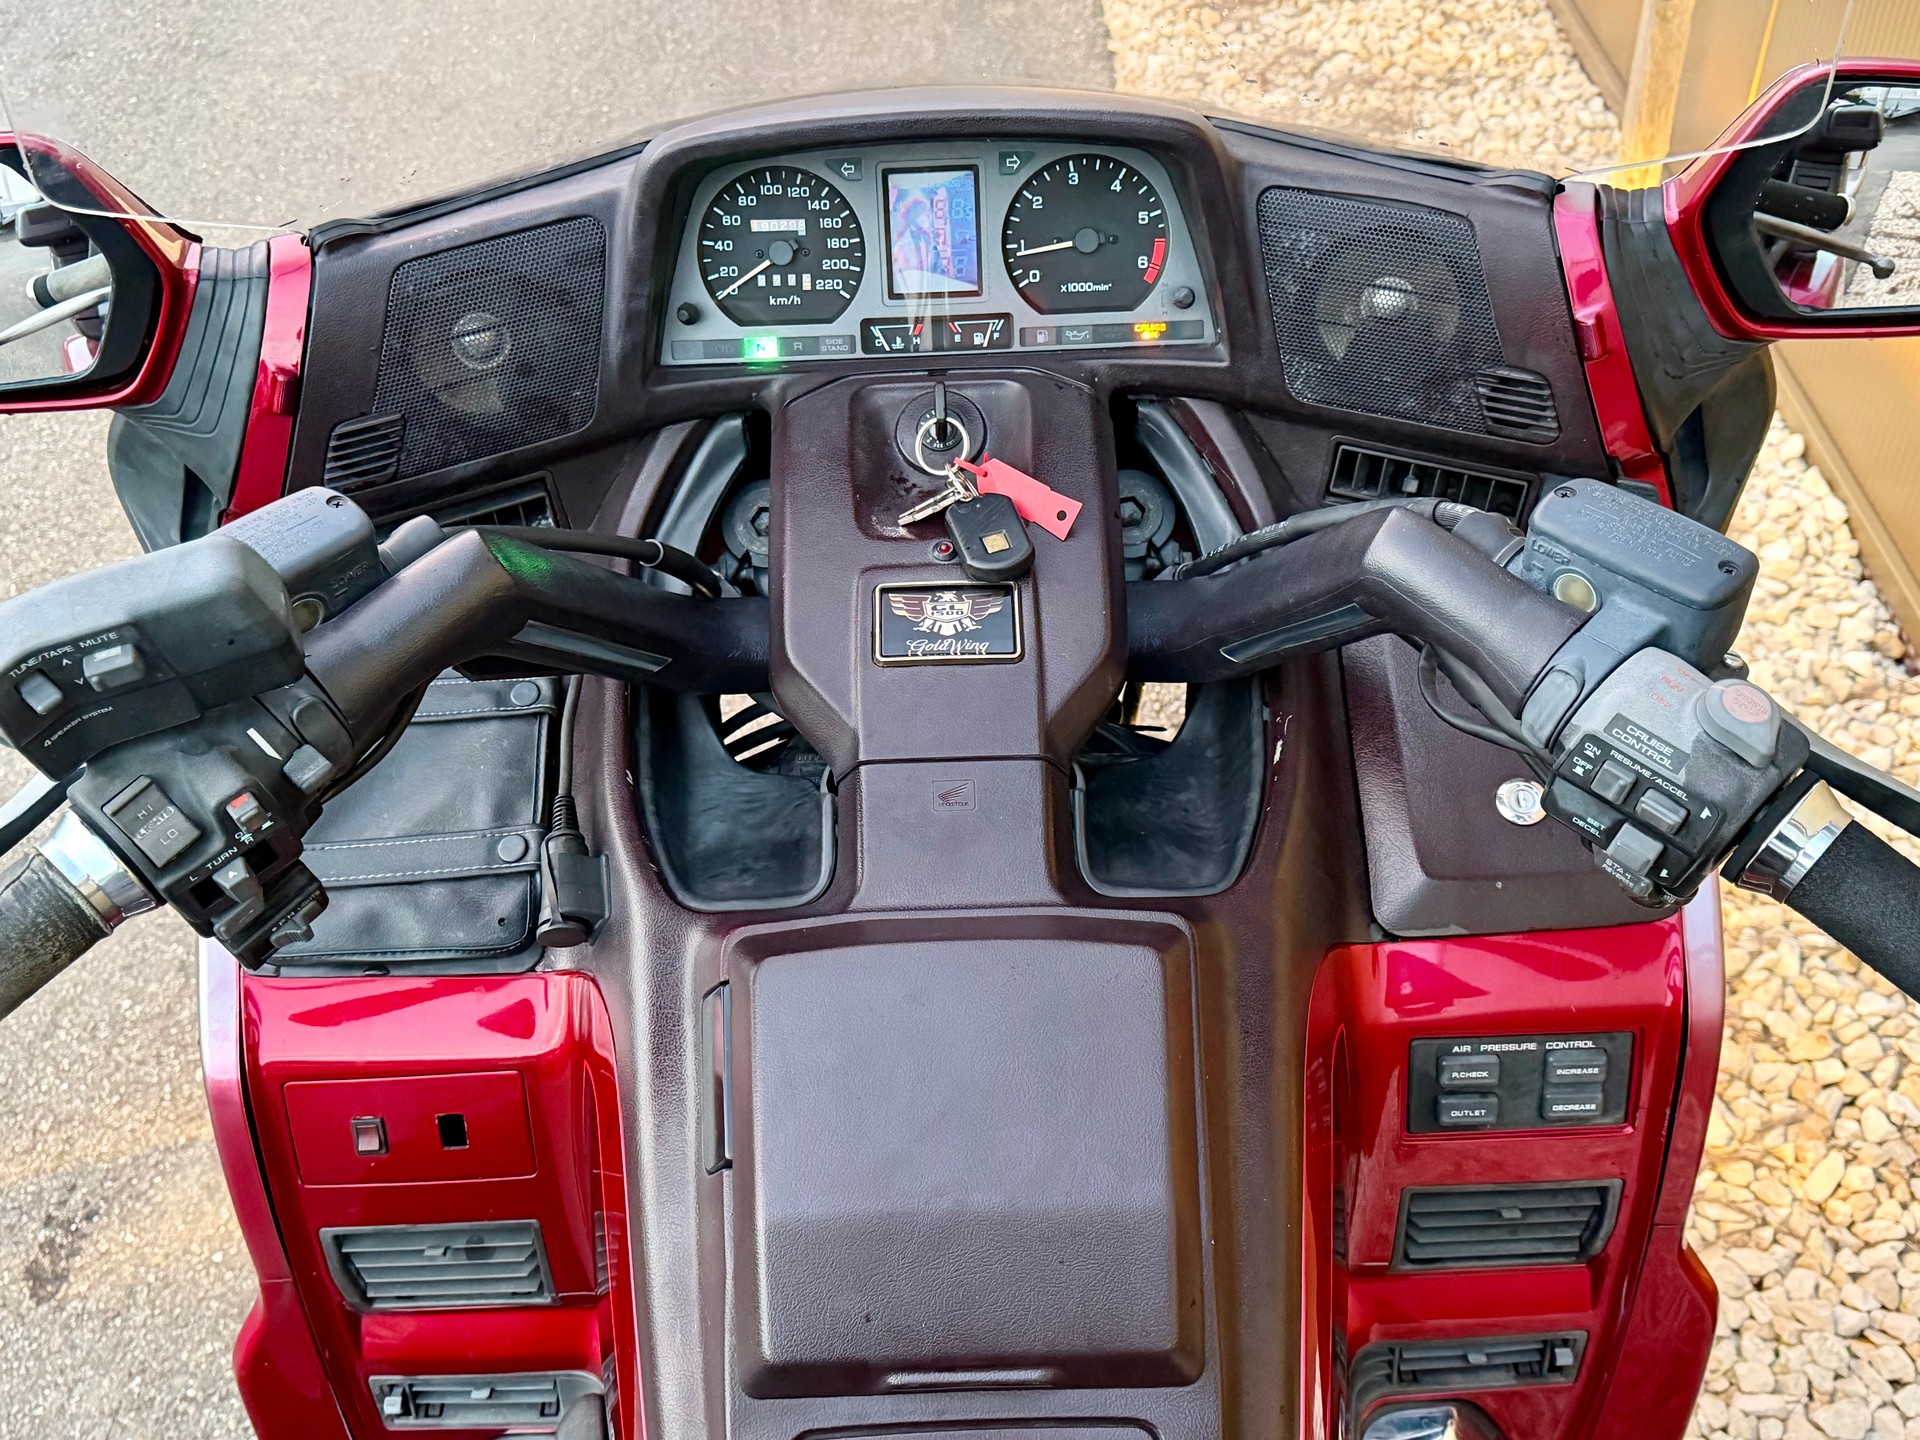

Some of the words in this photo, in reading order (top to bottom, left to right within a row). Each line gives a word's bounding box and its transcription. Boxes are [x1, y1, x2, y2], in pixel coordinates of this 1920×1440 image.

[1068, 174, 1079, 185] 3
[760, 185, 783, 196] 100
[1110, 180, 1122, 192] 4
[787, 187, 810, 198] 120
[738, 196, 757, 207] 80
[807, 200, 830, 211] 140
[1032, 197, 1043, 209] 2
[722, 215, 741, 226] 60
[819, 218, 842, 229] 160
[1138, 212, 1149, 224] 5
[714, 240, 733, 251] 40
[827, 238, 850, 249] 180
[822, 259, 850, 270] 200
[1138, 256, 1149, 268] 6
[720, 266, 739, 277] 20
[1029, 270, 1040, 282] 0
[815, 279, 843, 290] 220
[769, 295, 801, 306] km/h
[825, 338, 844, 346] SIDE
[913, 336, 921, 344] H
[955, 334, 961, 342] E
[993, 332, 1000, 341] F
[793, 342, 803, 352] R
[821, 344, 849, 352] STAND
[875, 338, 882, 347] C
[9, 645, 74, 678] TUNE/TAPE
[79, 632, 118, 648] MUTE
[1660, 674, 1684, 693] RUN
[44, 739, 52, 747] 4
[1626, 723, 1674, 757] CRUISE
[1584, 742, 1602, 756] ON
[1612, 727, 1674, 770] CONTROL
[1573, 756, 1594, 770] OFF
[1609, 749, 1689, 801] RESUME/ACCEL
[136, 804, 153, 819] HI
[1571, 816, 1601, 838] DECEL
[1586, 816, 1606, 830] SET
[160, 828, 178, 845] LO
[205, 846, 238, 870] TURN
[1452, 1045, 1471, 1053] AIR
[1480, 1042, 1537, 1052] PRESSURE
[1545, 1040, 1596, 1050] CONTROL
[1452, 1071, 1489, 1079] P.CHECK
[1556, 1067, 1599, 1075] INCREASE
[1451, 1109, 1486, 1117] OUTLET
[1552, 1103, 1597, 1112] DECREASE
